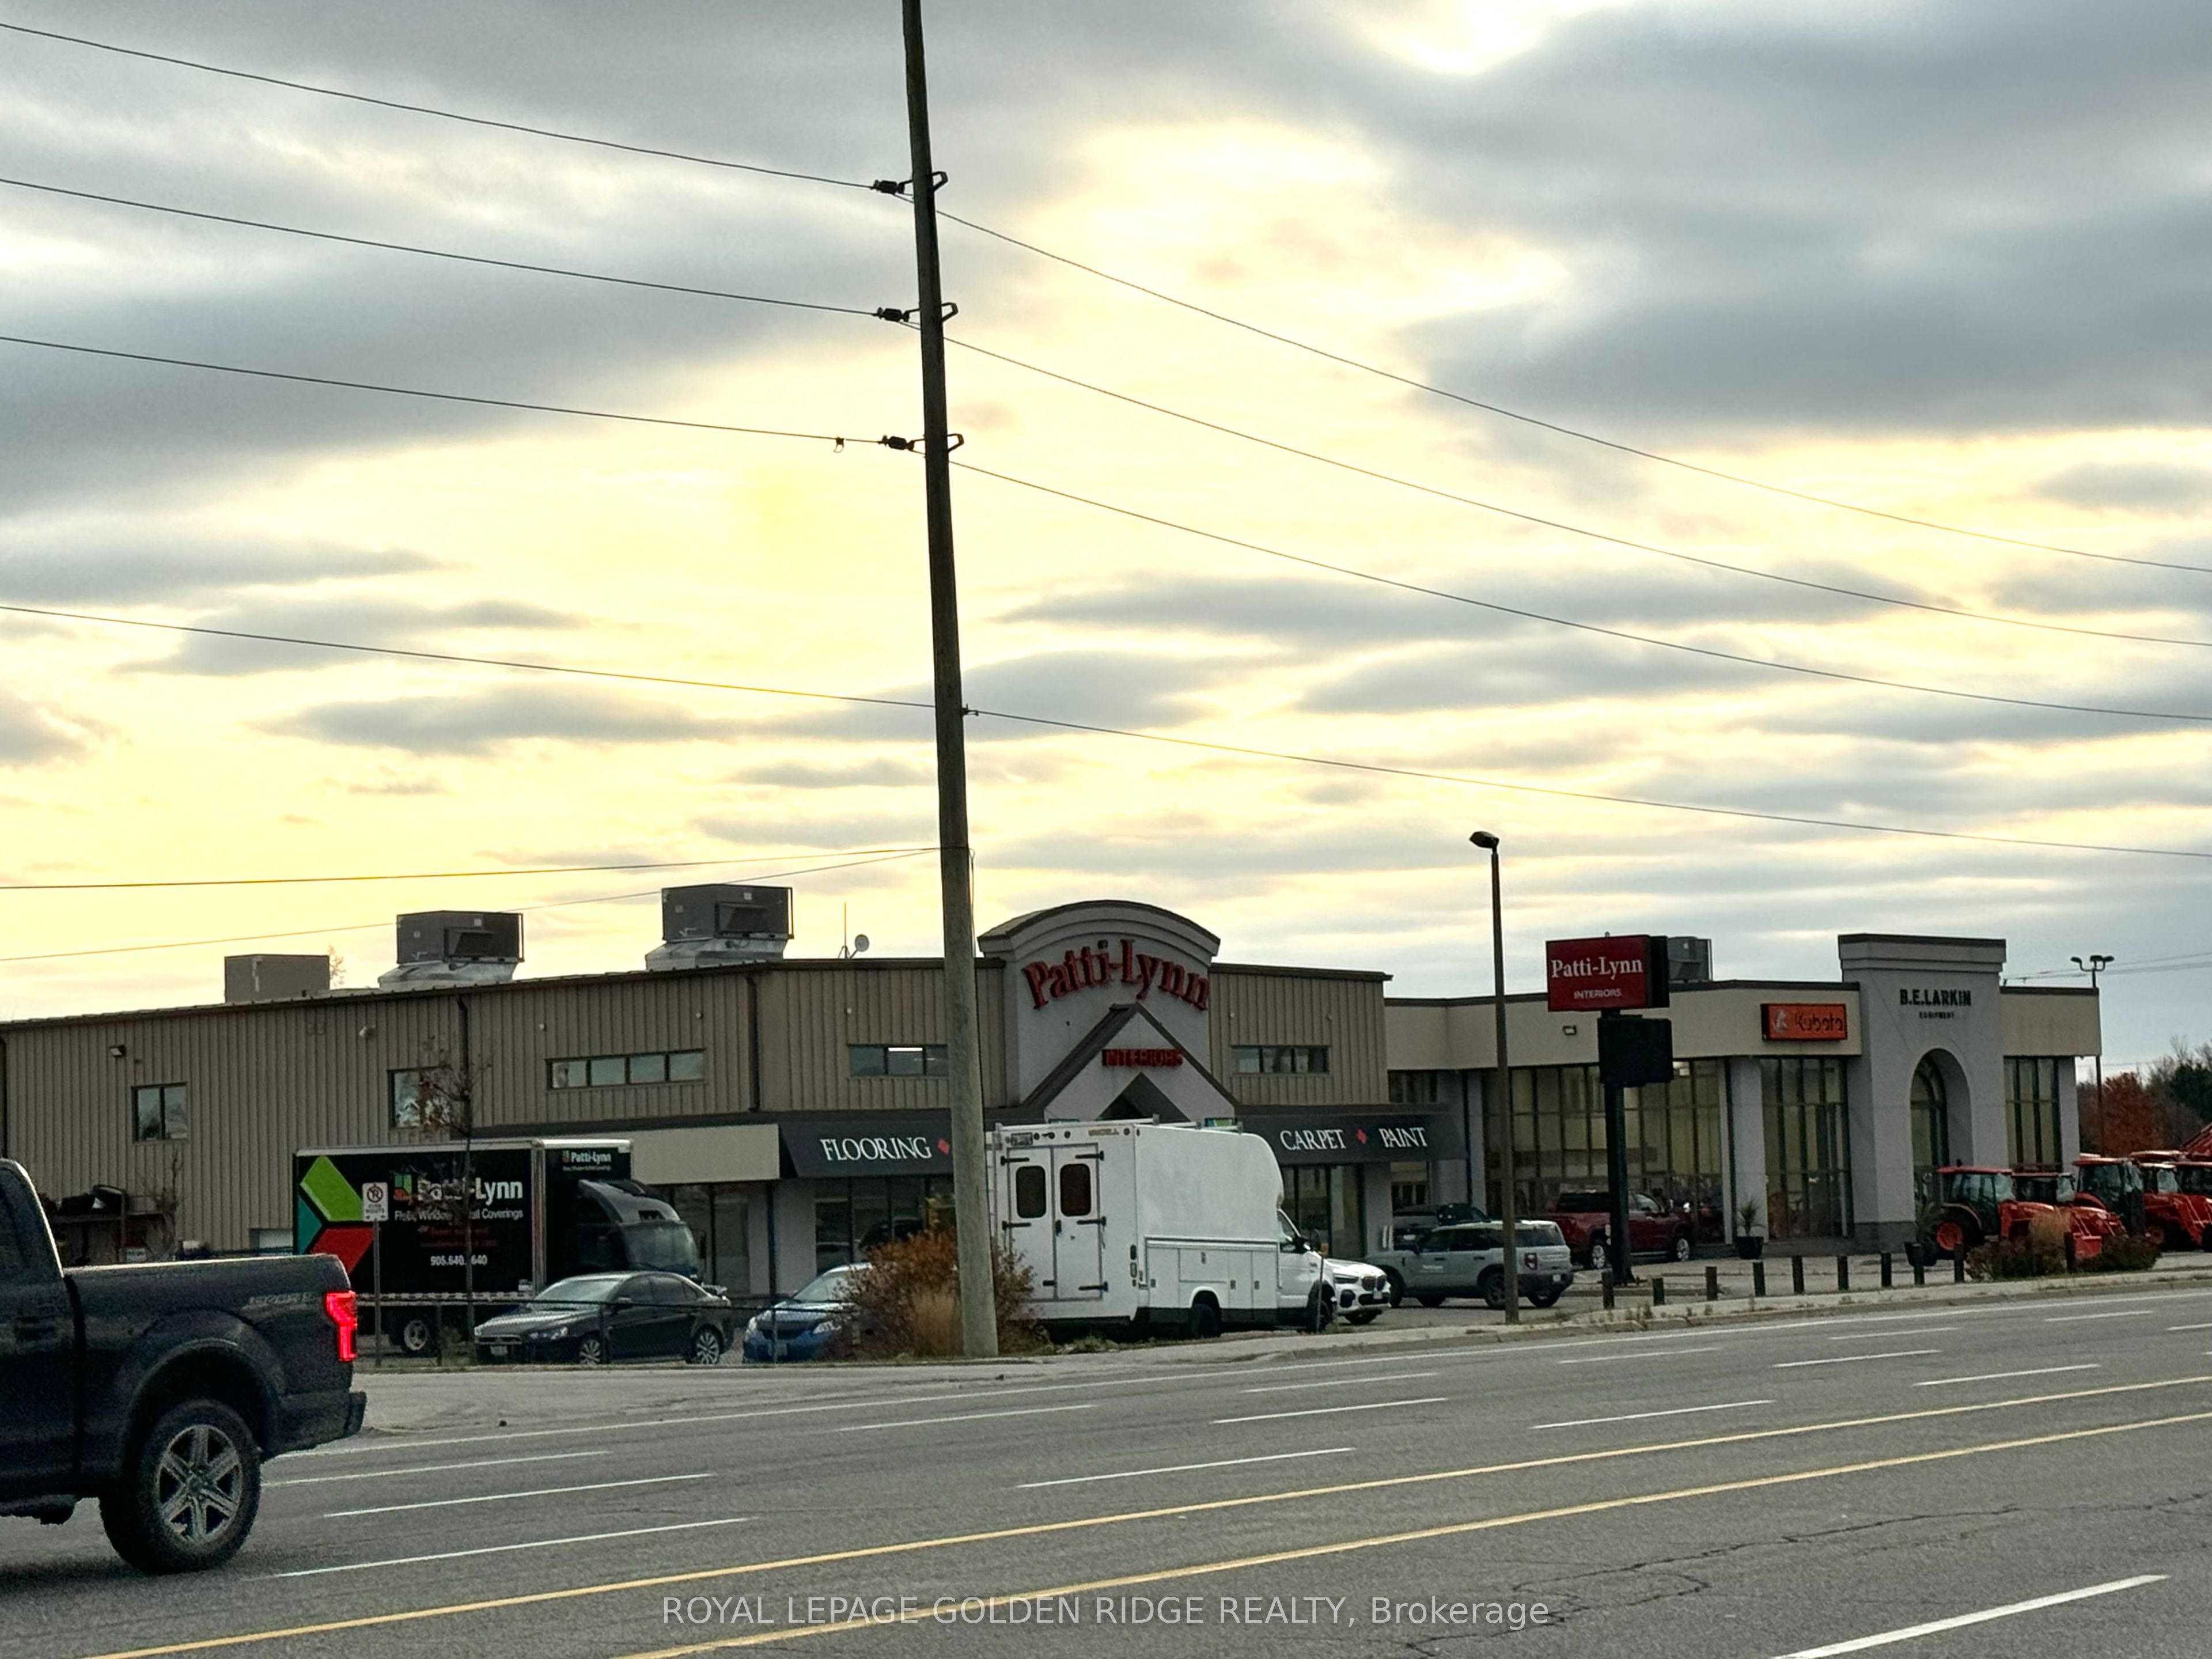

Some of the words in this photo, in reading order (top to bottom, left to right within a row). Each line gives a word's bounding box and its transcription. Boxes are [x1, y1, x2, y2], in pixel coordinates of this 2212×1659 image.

[1022, 939, 1209, 1010] Patti-Lynn
[1551, 956, 1643, 980] Patti-Lynn
[1574, 988, 1622, 999] INTERIORS
[1104, 1049, 1184, 1067] INTERIORS
[1280, 1129, 1347, 1150] CARPET
[1379, 1127, 1427, 1148] PAINT
[820, 1137, 932, 1161] FLOORING
[482, 1208, 524, 1221] Coverings
[430, 1254, 488, 1266] 905.640.640
